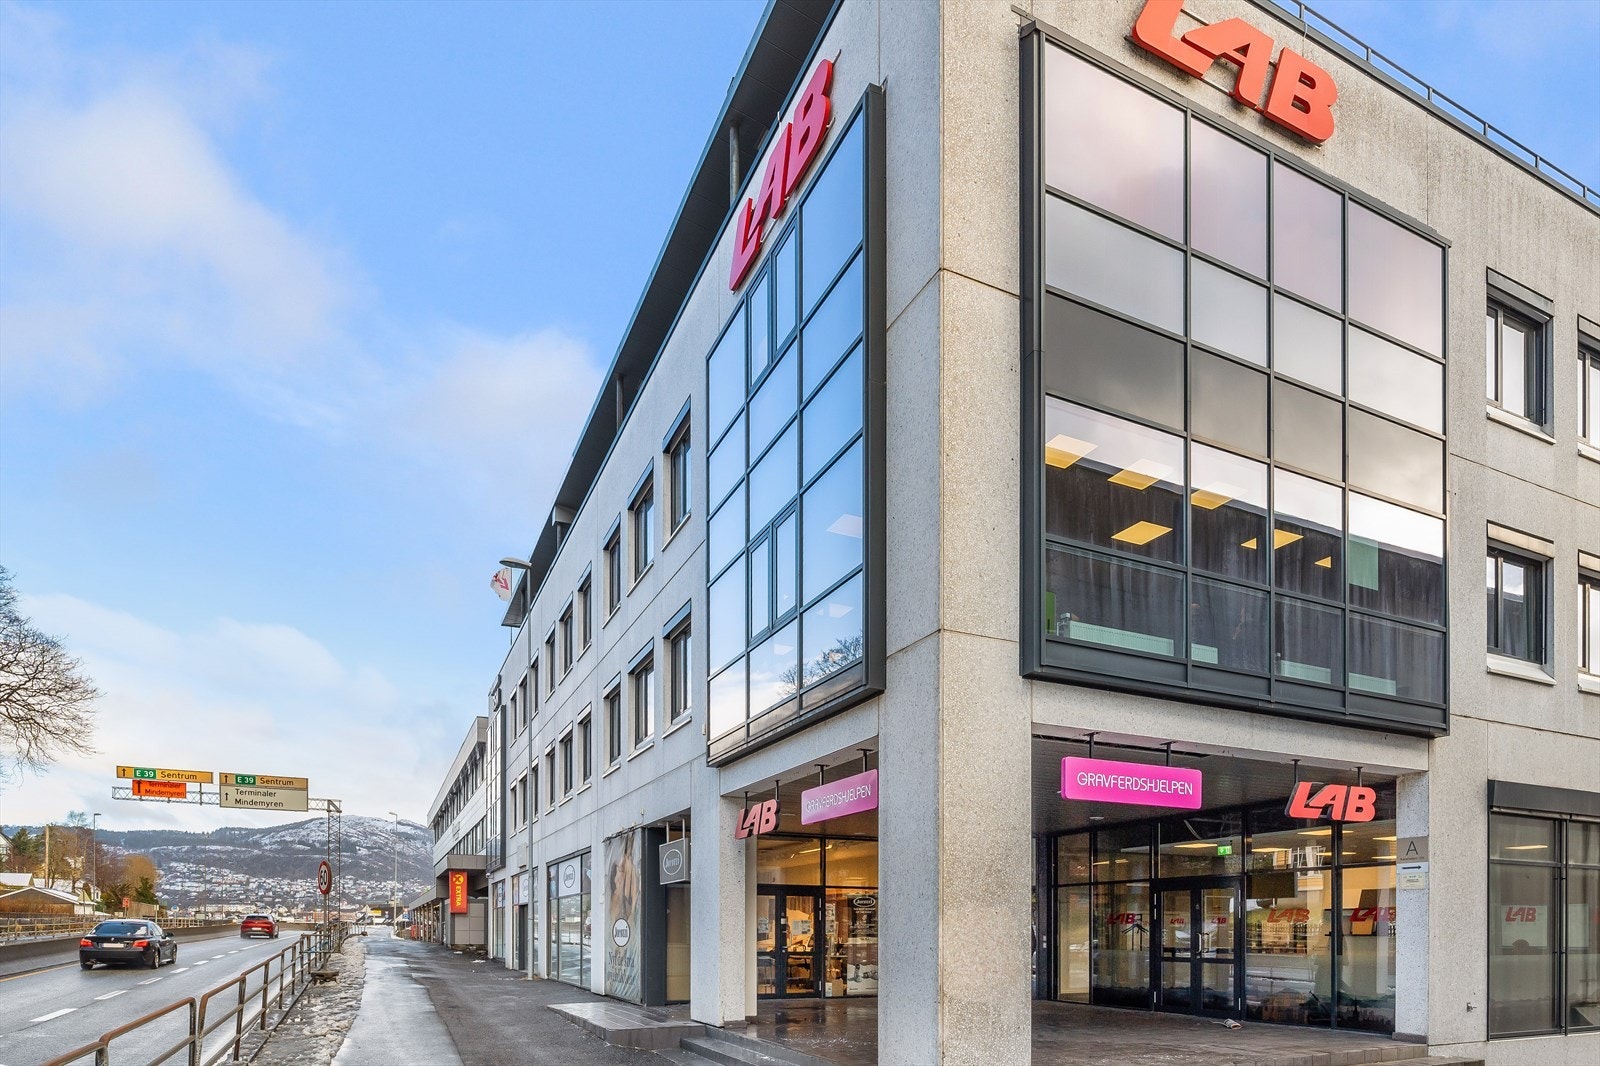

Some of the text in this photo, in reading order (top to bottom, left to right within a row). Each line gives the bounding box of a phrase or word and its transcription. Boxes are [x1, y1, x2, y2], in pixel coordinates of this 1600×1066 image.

[1132, 0, 1338, 144] LAB
[729, 58, 833, 291] LAB
[136, 769, 197, 780] E 39 Sentrum
[260, 777, 294, 786] Sentrum
[1077, 771, 1193, 796] GRAVFERDSHJELPEN
[144, 788, 185, 797] Mindemyren
[235, 788, 277, 797] Terminaler
[235, 798, 284, 808] Mindemyren
[1286, 781, 1377, 822] LAB
[735, 798, 780, 840] LAB
[1405, 840, 1419, 856] A
[1266, 908, 1311, 923] LAB
[1505, 906, 1537, 922] LAB
